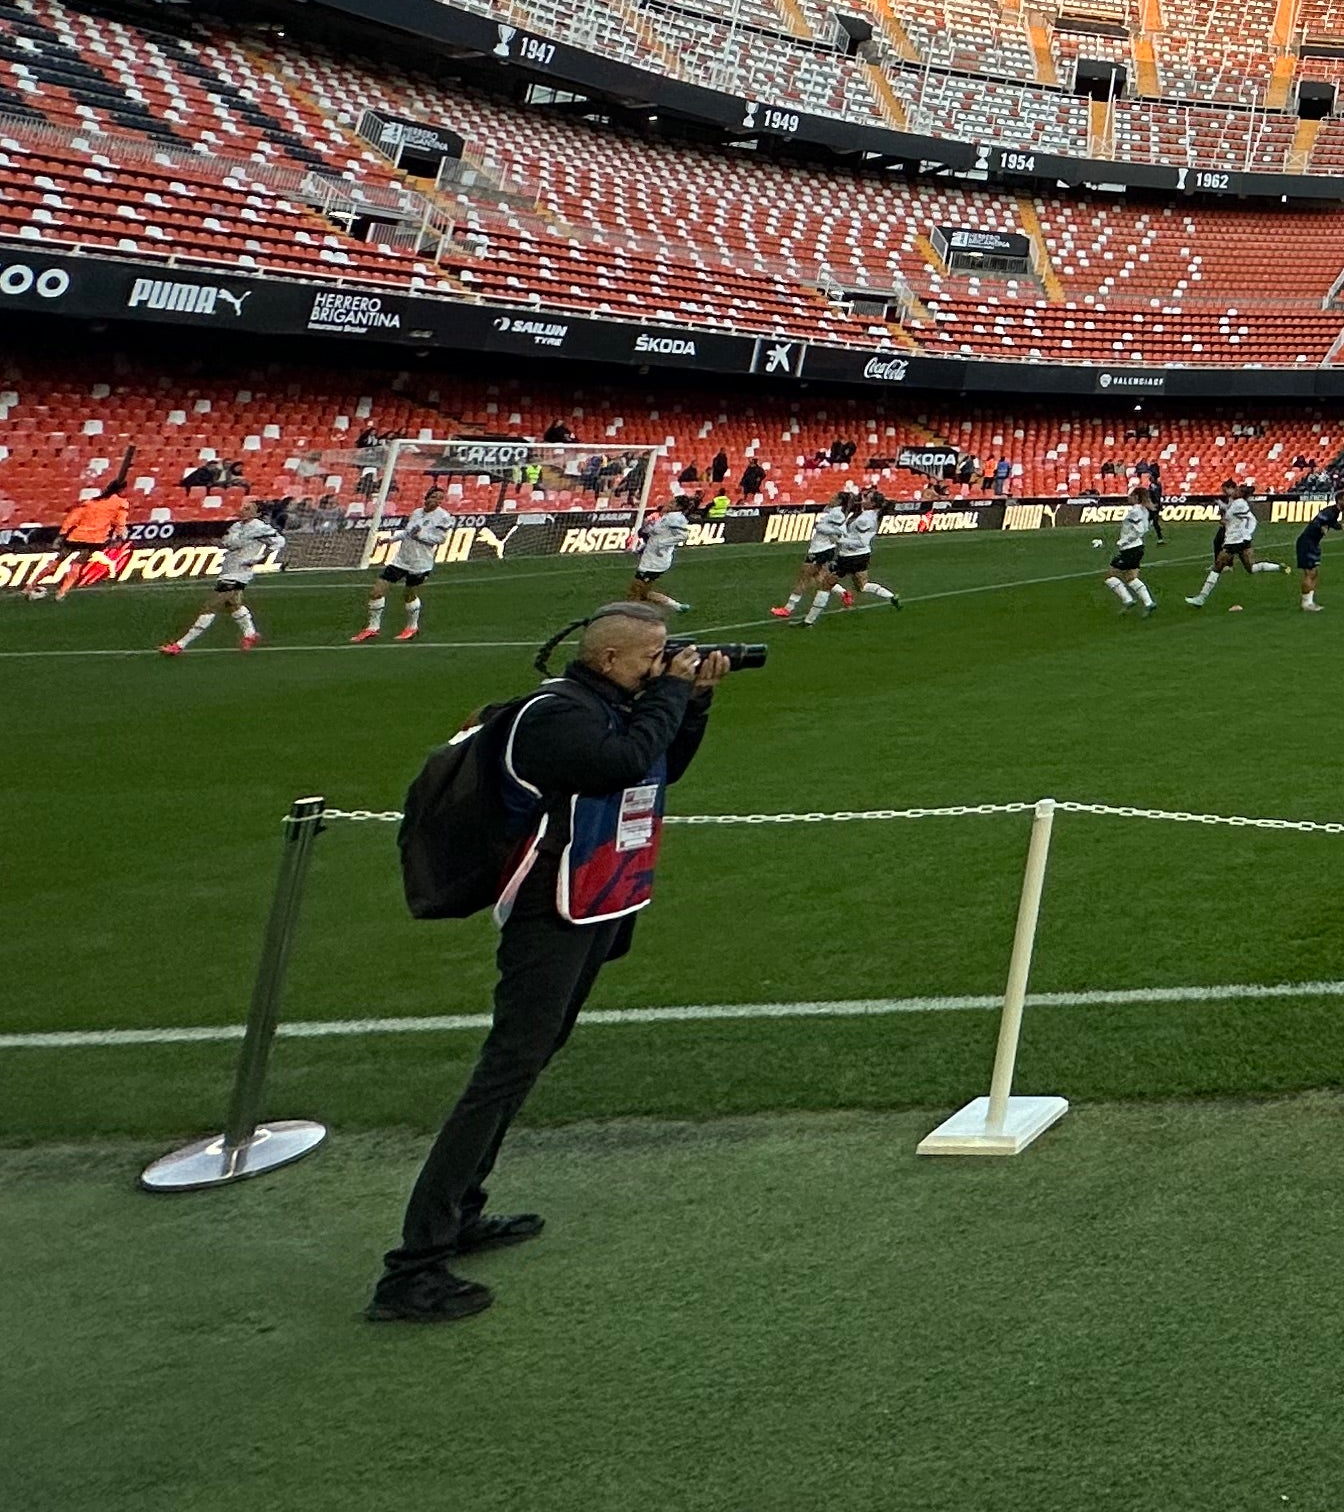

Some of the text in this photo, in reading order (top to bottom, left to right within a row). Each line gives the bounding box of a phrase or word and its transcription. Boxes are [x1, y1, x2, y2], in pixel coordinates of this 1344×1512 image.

[519, 36, 556, 65] 1947
[764, 110, 800, 133] 1949
[1000, 152, 1036, 172] 1954
[1196, 172, 1230, 190] 1962
[128, 278, 218, 316] PUMA
[314, 292, 382, 312] HERRERO
[310, 306, 401, 329] BRIGANTINA
[511, 320, 569, 337] SAILUN
[534, 336, 564, 347] TYRE
[634, 333, 696, 356] ŠKODA
[899, 450, 957, 467] ŠKODA
[877, 511, 979, 535] FASTER FOOTBALL
[1002, 504, 1045, 531] PUMA
[559, 526, 632, 554] FASTER
